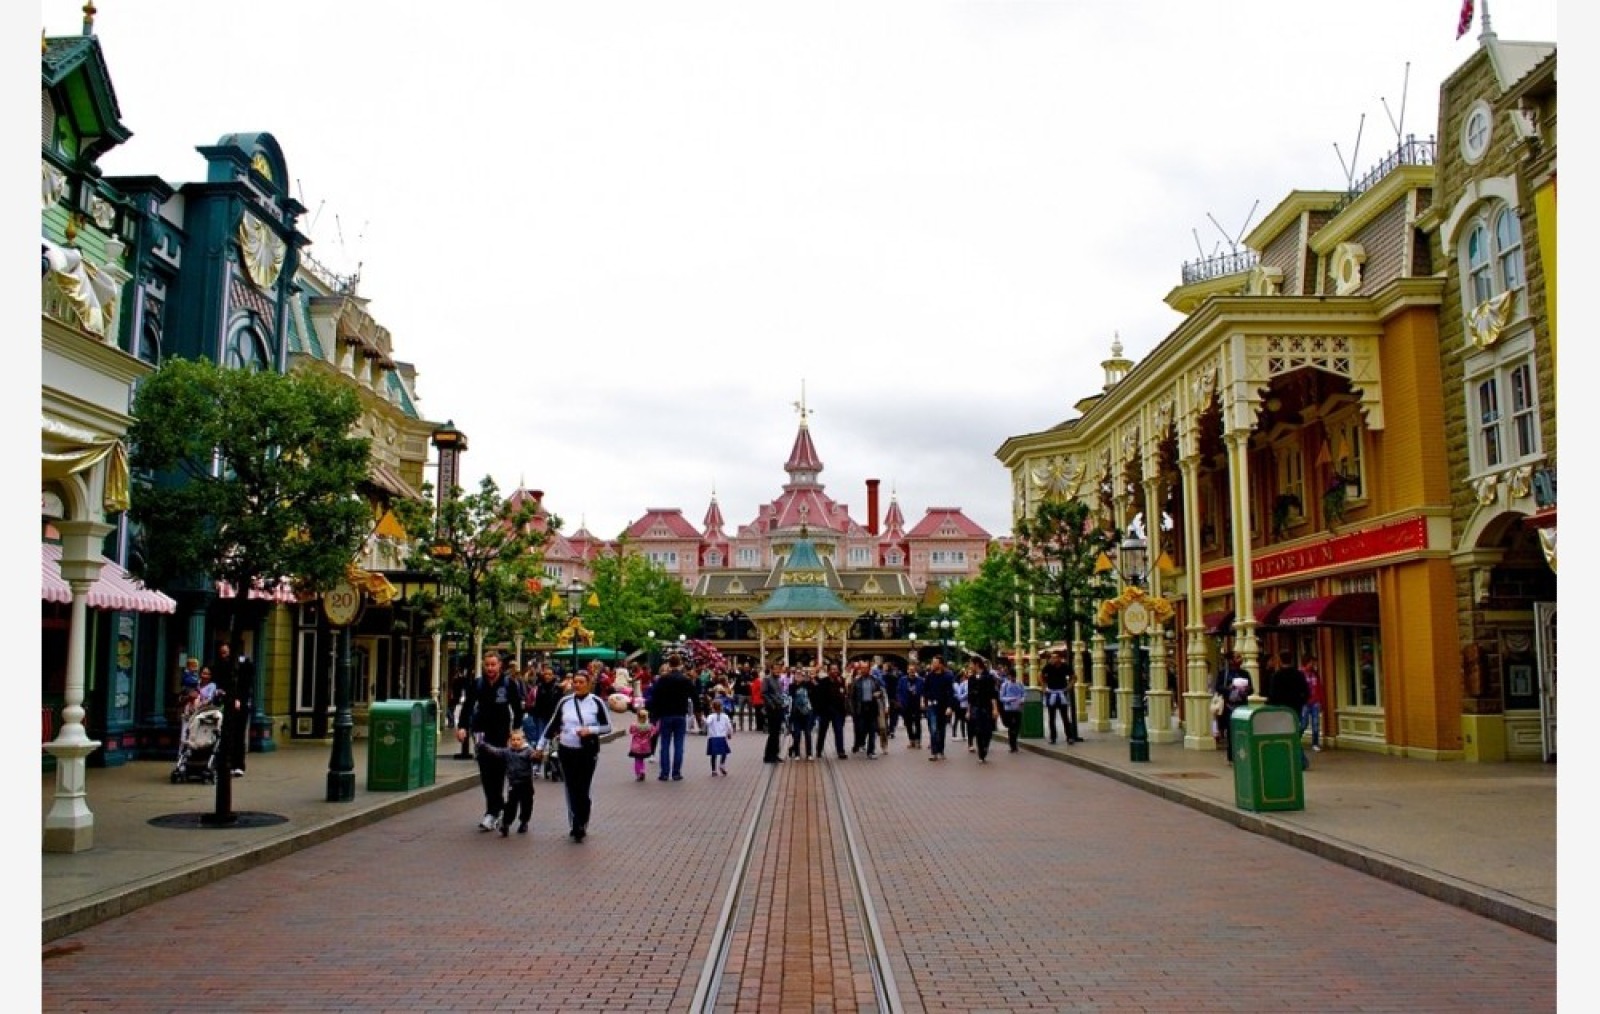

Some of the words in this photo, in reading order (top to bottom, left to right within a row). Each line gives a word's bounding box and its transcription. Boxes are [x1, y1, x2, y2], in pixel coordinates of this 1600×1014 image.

[1254, 546, 1333, 575] MPORIUM
[332, 593, 352, 608] 20
[1128, 610, 1145, 622] 20
